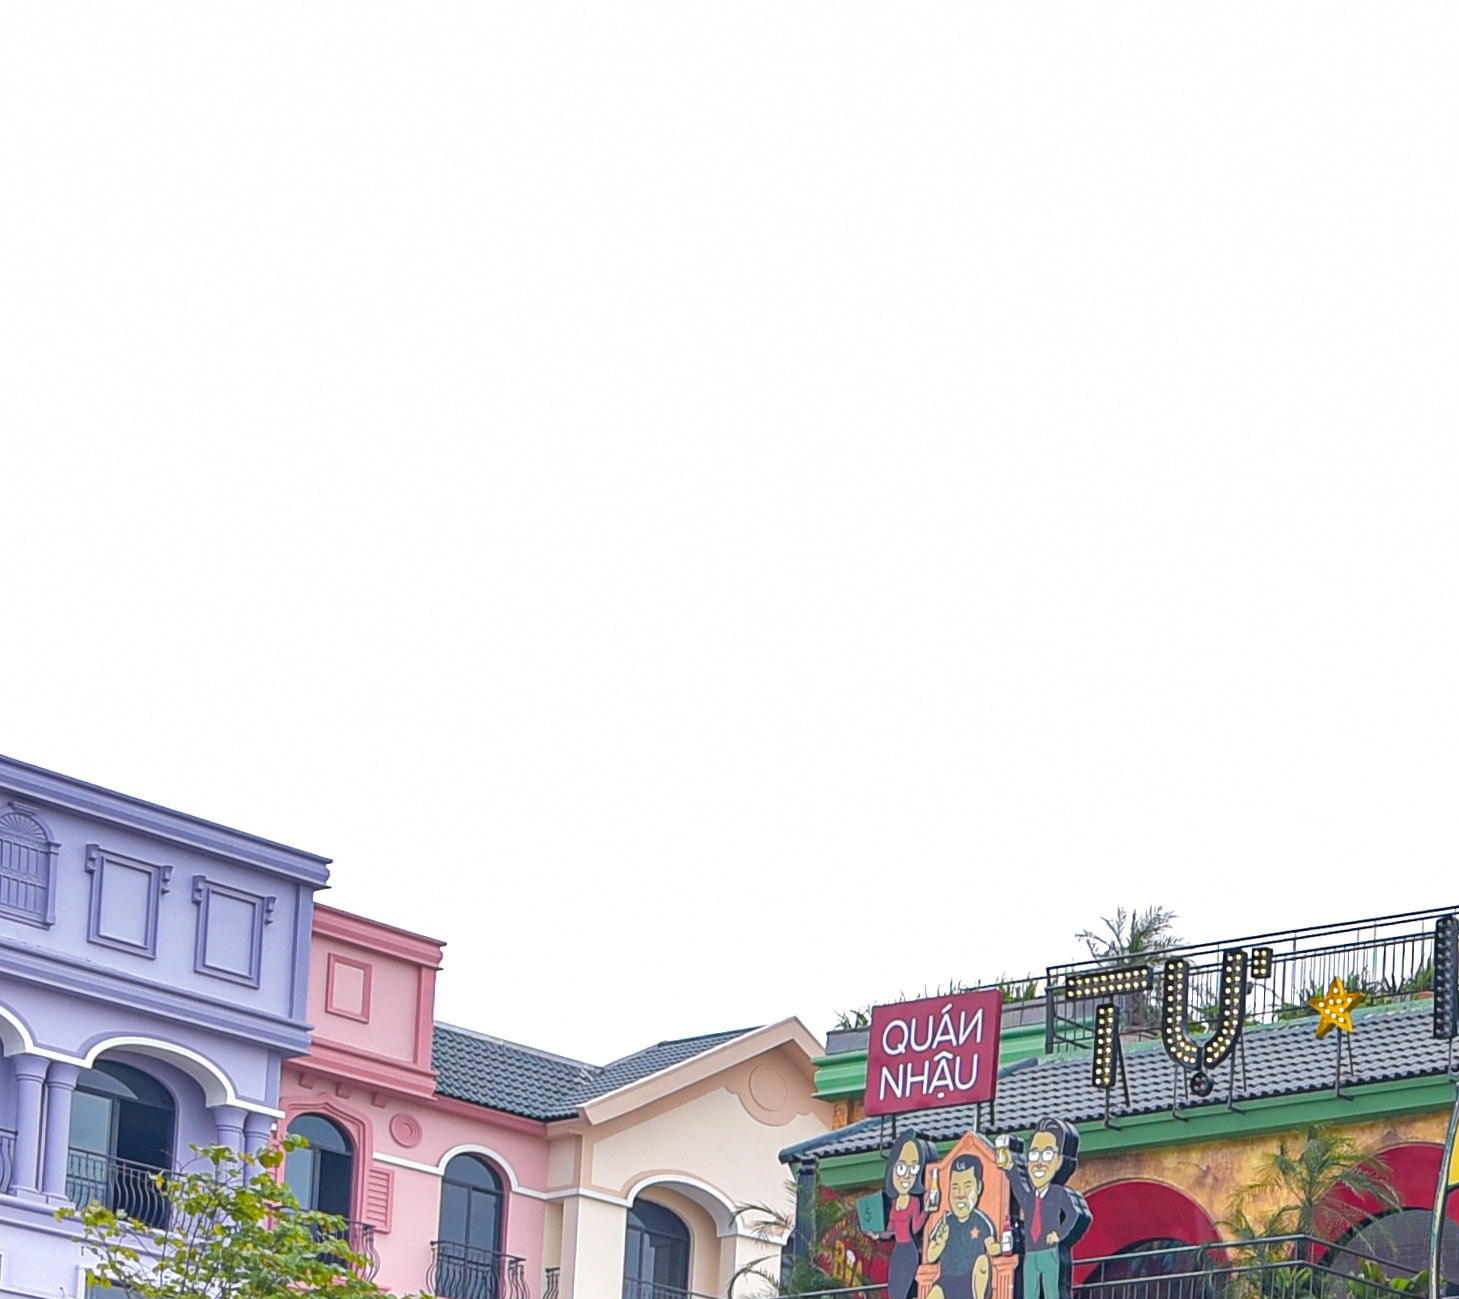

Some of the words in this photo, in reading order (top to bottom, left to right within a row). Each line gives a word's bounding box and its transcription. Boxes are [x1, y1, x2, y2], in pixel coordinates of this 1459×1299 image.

[882, 1003, 984, 1056] QUÁN
[1065, 947, 1272, 1098] TỰ
[879, 1050, 979, 1101] NHẬU
